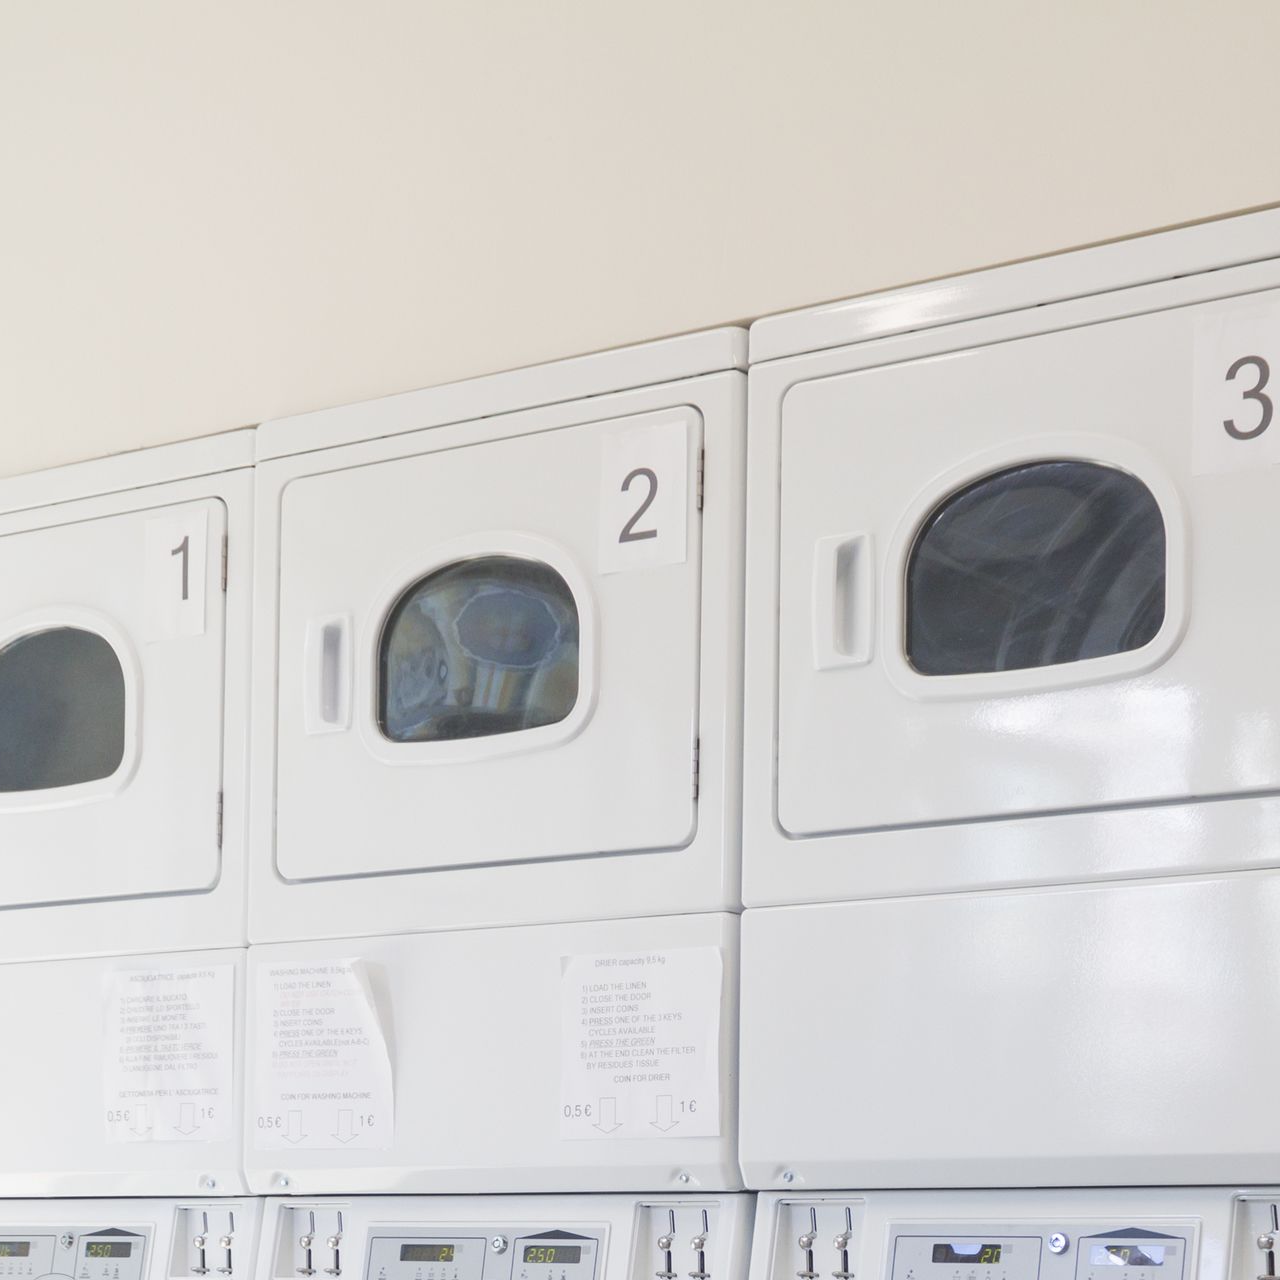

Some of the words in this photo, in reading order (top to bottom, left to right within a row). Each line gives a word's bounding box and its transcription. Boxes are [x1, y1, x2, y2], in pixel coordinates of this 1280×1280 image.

[1224, 356, 1273, 440] 3
[619, 468, 657, 543] 2
[172, 536, 189, 600] 1
[595, 958, 617, 968] DRIER
[618, 958, 645, 968] capacity
[589, 983, 609, 993] LOAD
[611, 983, 624, 991] THE
[625, 981, 647, 990] LINEN
[589, 994, 613, 1003] CLOSE
[615, 994, 629, 1002] THE
[630, 992, 651, 1001] DOOR
[589, 1006, 615, 1014] INSERT
[616, 1004, 639, 1013] COINS
[589, 1017, 613, 1027] PRESS
[615, 1016, 630, 1024] ONE
[631, 1015, 641, 1023] OF
[643, 1014, 656, 1022] THE
[663, 1013, 682, 1021] KEYS
[588, 1028, 616, 1037] CYCLES
[618, 1026, 656, 1035] AVAILABLE
[588, 1040, 613, 1049] PRESS
[615, 1038, 629, 1048] THE
[630, 1037, 655, 1047] GREEN
[588, 1050, 598, 1059] AT
[600, 1049, 613, 1058] THE
[615, 1049, 630, 1057] END
[631, 1048, 655, 1057] CLEAN
[656, 1047, 670, 1055] THE
[671, 1046, 695, 1055] FILTER
[586, 1062, 596, 1070] BY
[597, 1060, 633, 1069] RESIDUES
[635, 1059, 660, 1068] TISSUE
[613, 1075, 631, 1084] COIN
[632, 1074, 647, 1082] FOR
[648, 1073, 670, 1082] DRIER
[584, 1104, 592, 1117] €
[680, 1101, 685, 1113] 1
[689, 1099, 697, 1113] €
[123, 1110, 130, 1122] €
[201, 1108, 205, 1119] 1
[208, 1107, 215, 1119] €
[275, 1116, 282, 1128] €
[359, 1115, 364, 1127] 1
[367, 1114, 375, 1127] €
